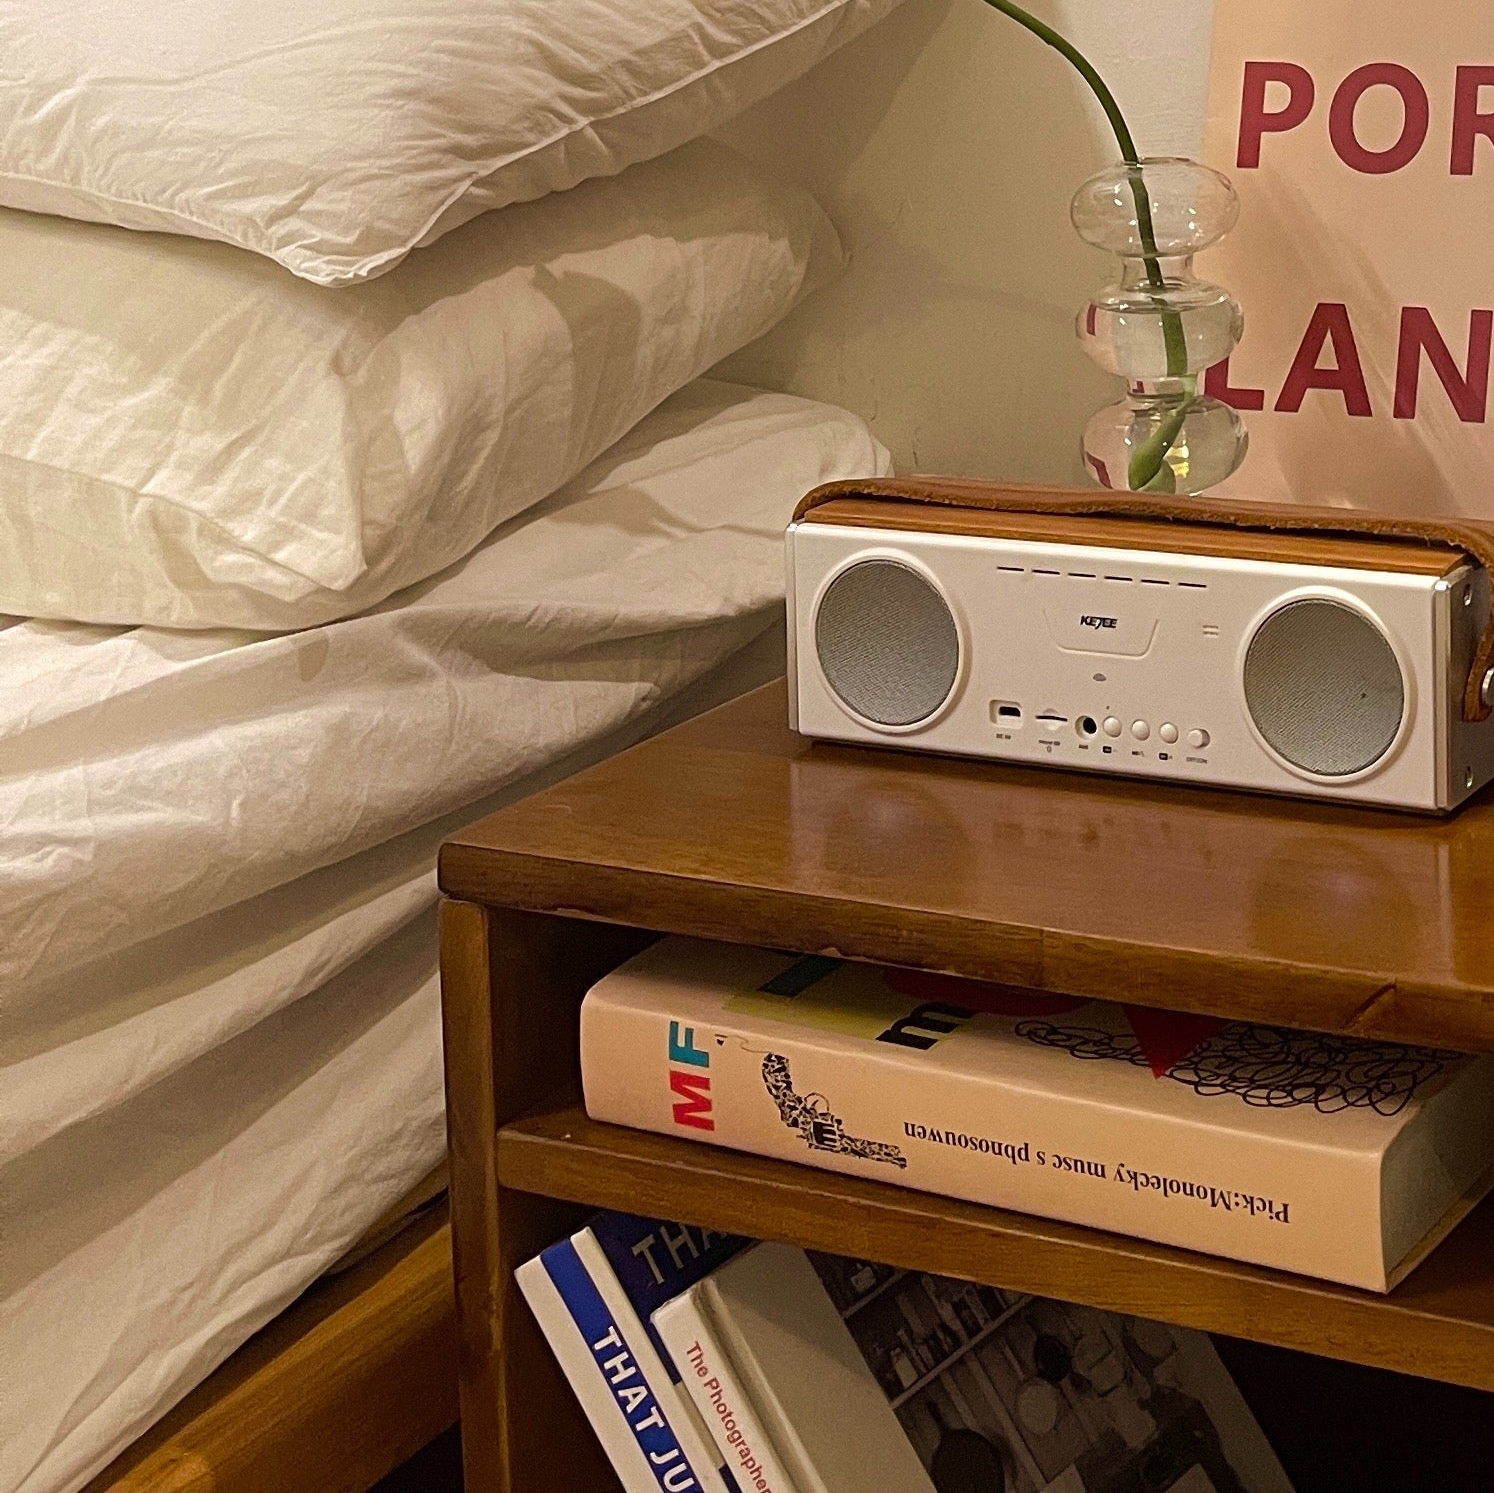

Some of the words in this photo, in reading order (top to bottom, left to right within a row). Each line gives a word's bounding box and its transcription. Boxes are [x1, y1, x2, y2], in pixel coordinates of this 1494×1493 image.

[593, 1325, 666, 1433] THAT
[686, 1340, 709, 1379] The
[650, 1448, 696, 1493] JU
